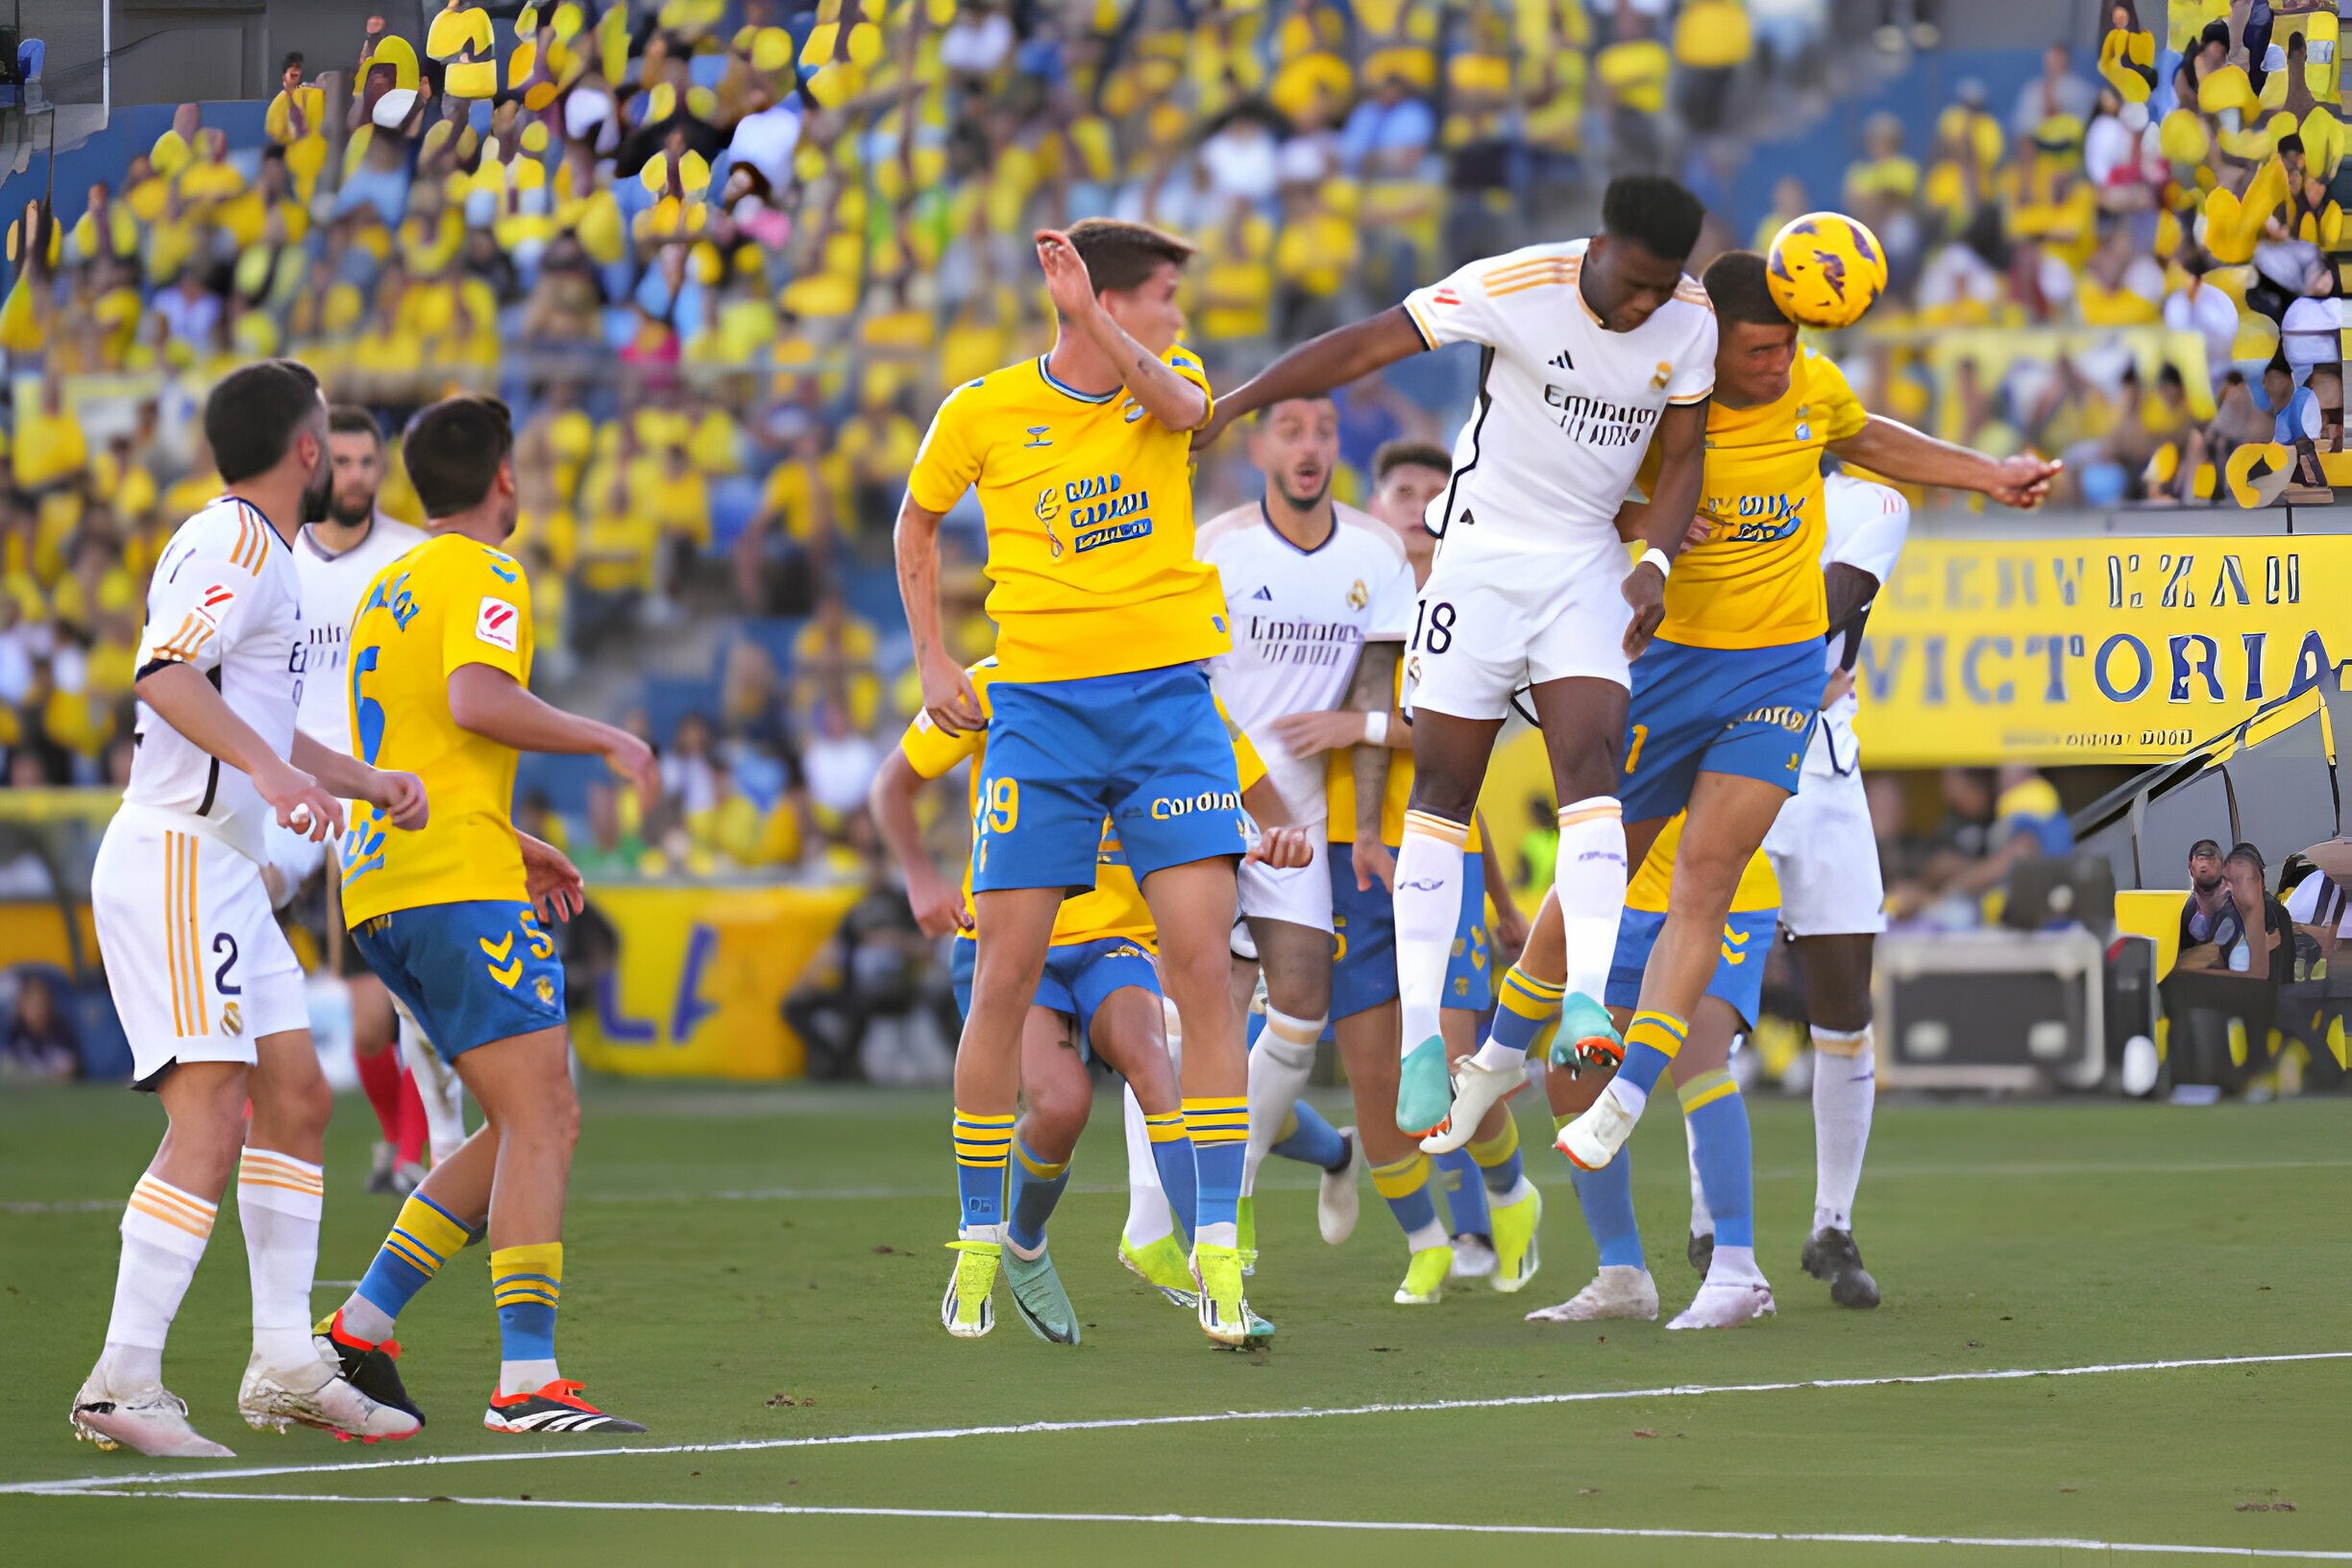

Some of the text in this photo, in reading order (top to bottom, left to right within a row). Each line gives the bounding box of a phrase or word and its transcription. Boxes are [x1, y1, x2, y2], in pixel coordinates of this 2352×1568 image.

[1411, 599, 1457, 654] 18
[1860, 628, 2333, 705] VICTORIA
[212, 932, 242, 995] 2
